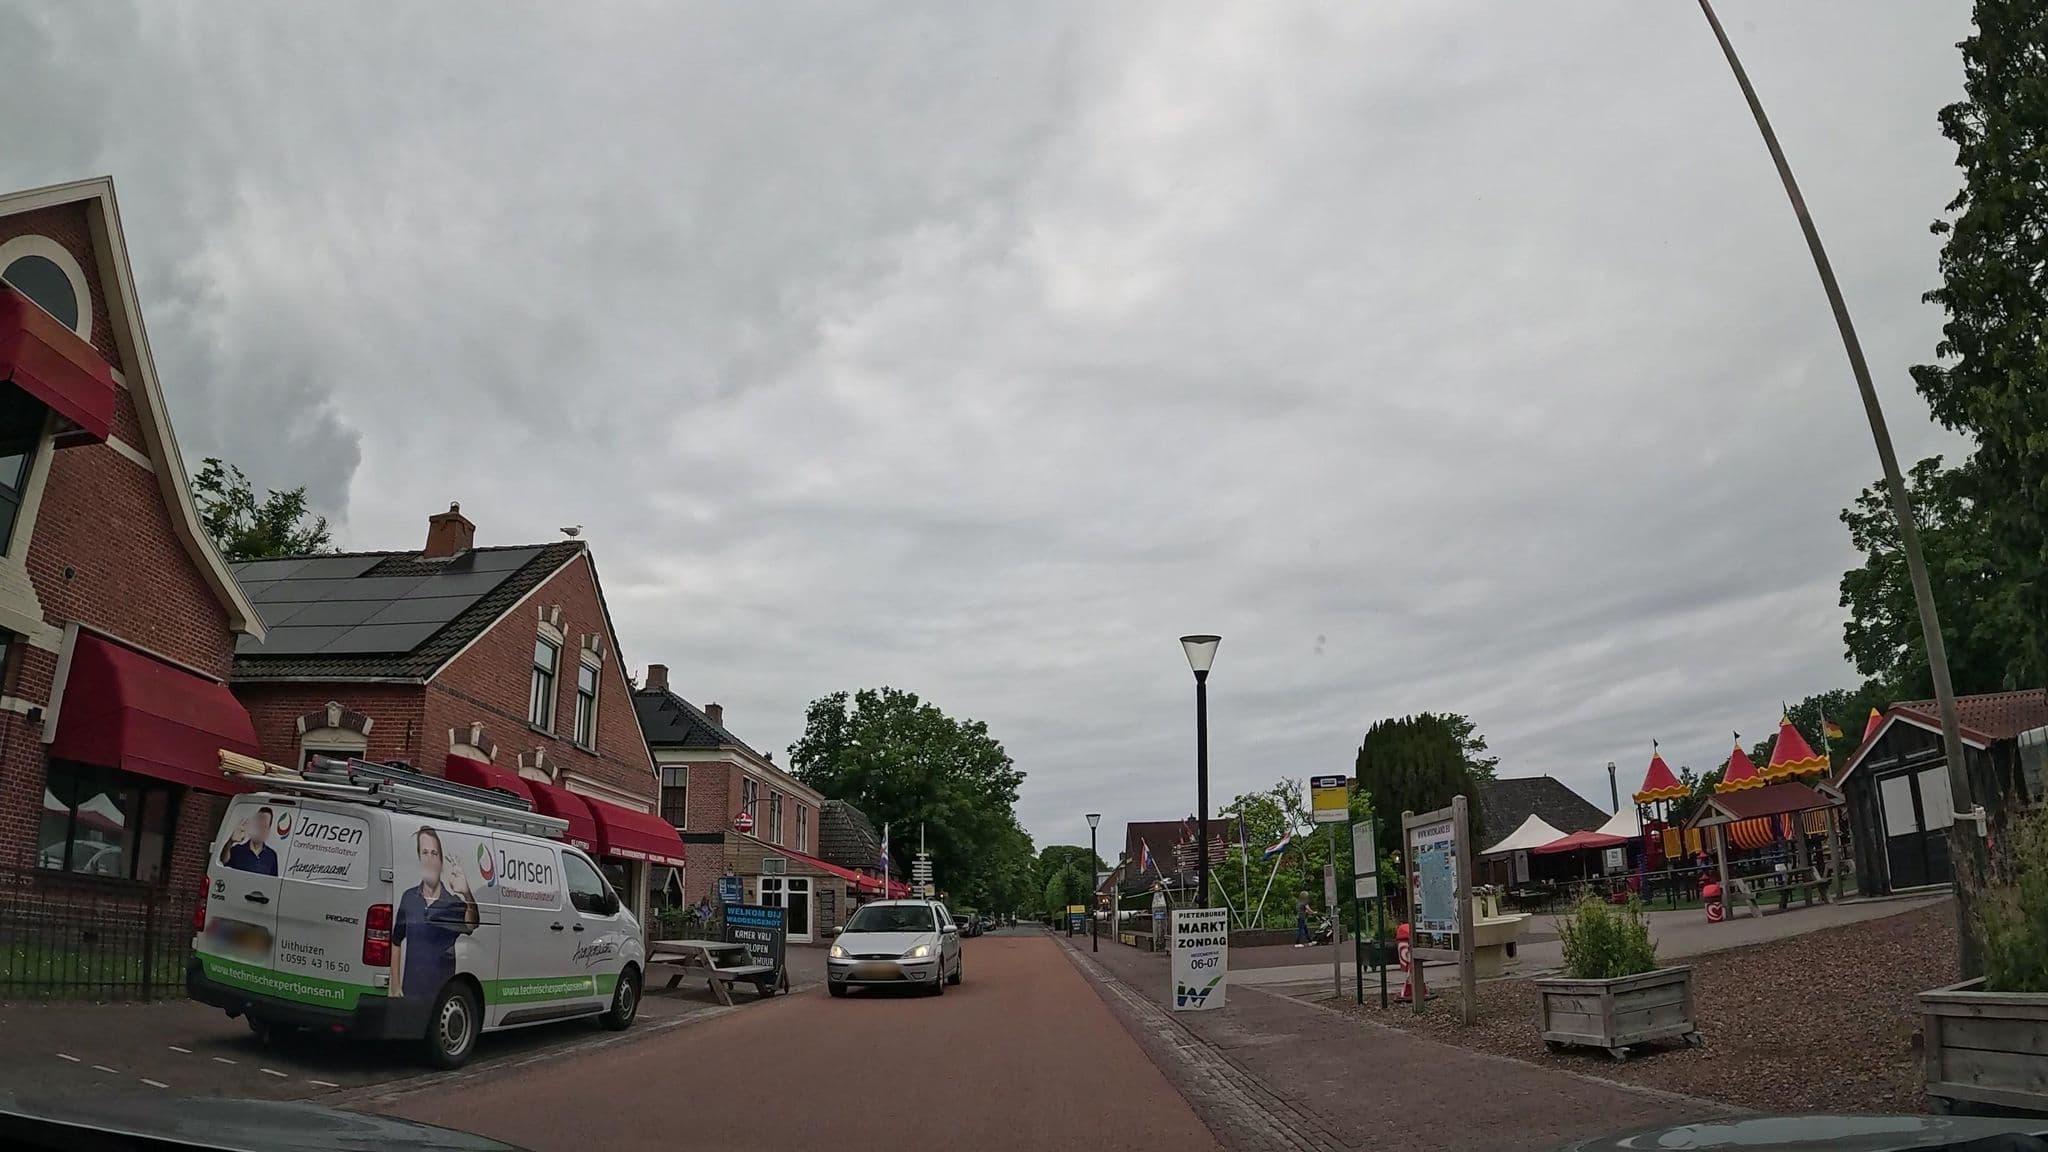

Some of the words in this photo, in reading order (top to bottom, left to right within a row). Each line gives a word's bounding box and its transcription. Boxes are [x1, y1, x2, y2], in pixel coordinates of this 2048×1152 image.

[295, 816, 363, 845] Jansen
[293, 840, 358, 857] Comfortinstallateur
[499, 850, 553, 885] Jansen
[727, 907, 766, 918] WELKOM
[767, 910, 781, 919] BIJ
[1178, 911, 1226, 919] PIETERBUREN
[325, 914, 360, 926] PROACE
[1178, 921, 1226, 934] MARKT
[735, 930, 756, 940] KAMER
[281, 939, 325, 956] Uithuizen
[1178, 937, 1227, 948] ZONDAG
[286, 954, 307, 967] 0595
[311, 958, 322, 968] 43
[326, 960, 336, 971] 16
[338, 962, 350, 973] 50
[1191, 957, 1219, 970] 06-07
[210, 962, 345, 1000] www.technischexpertjansen.nl
